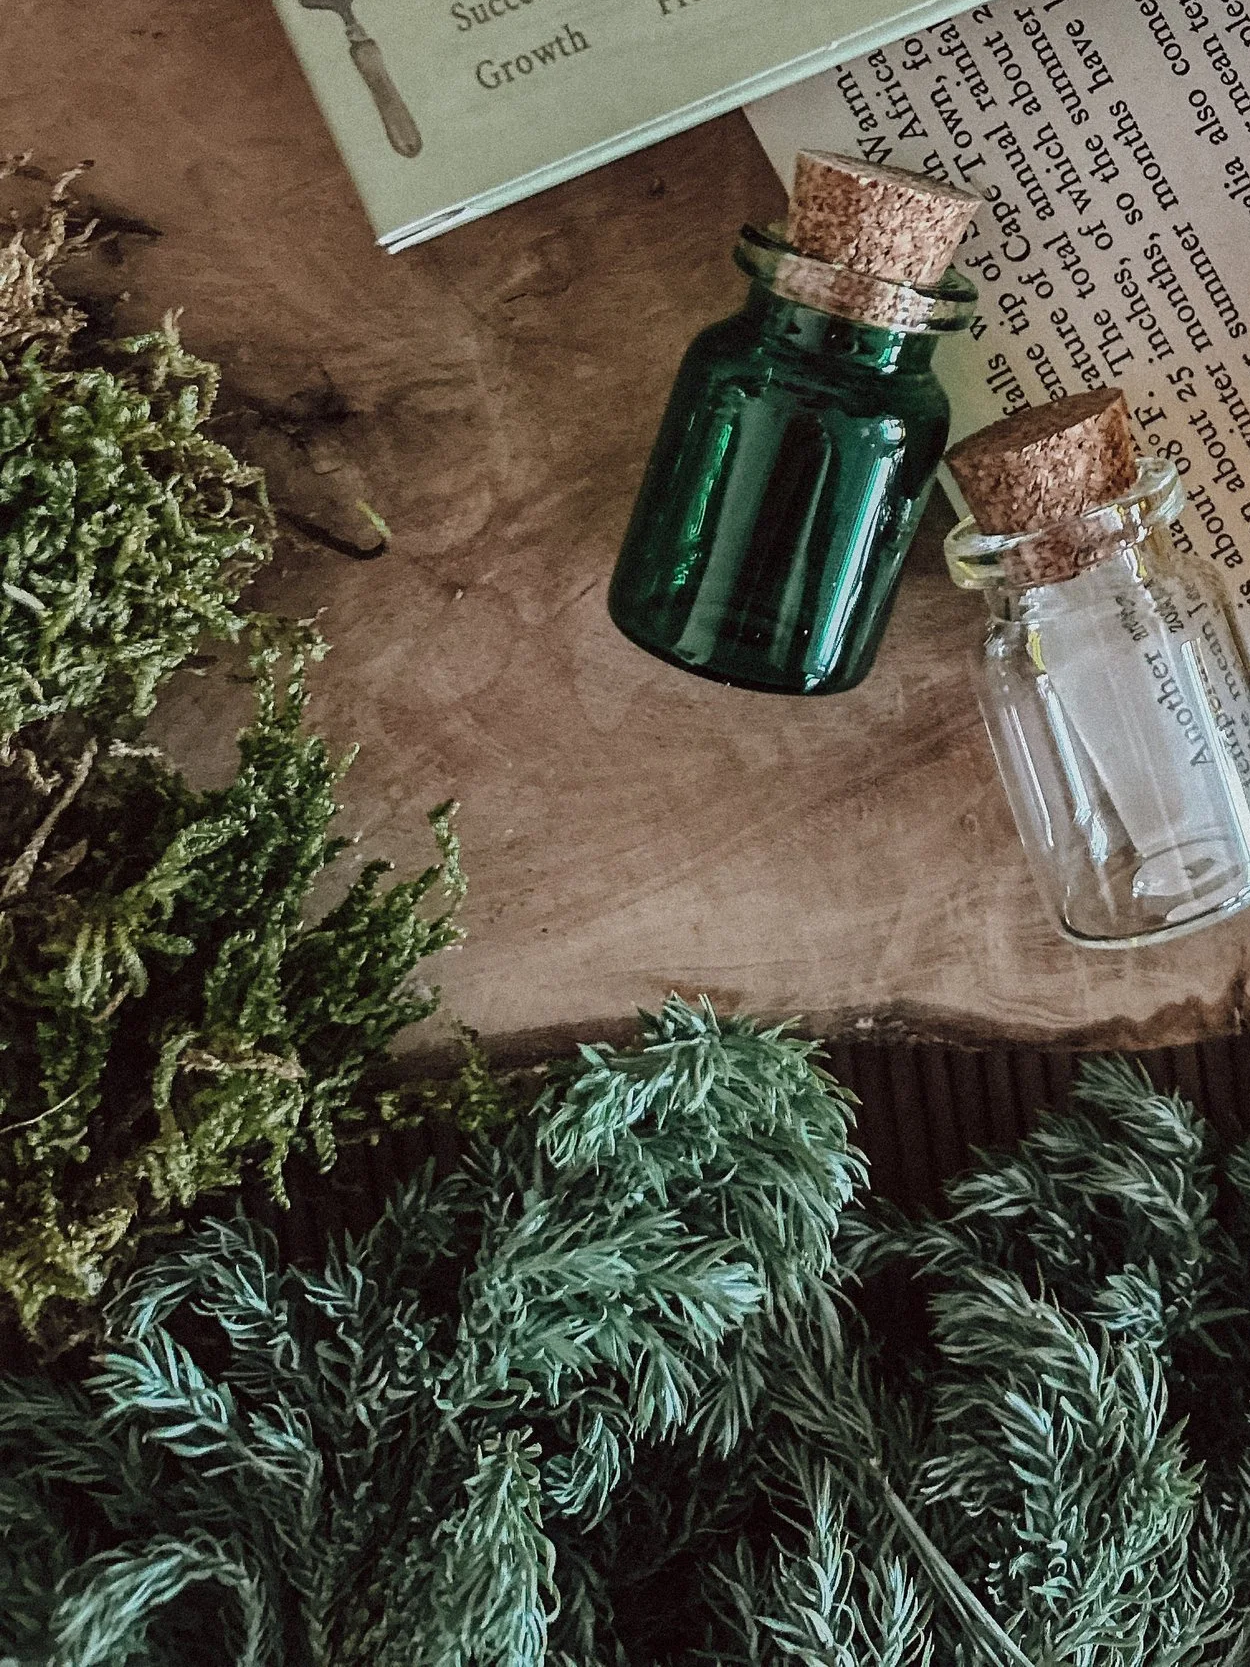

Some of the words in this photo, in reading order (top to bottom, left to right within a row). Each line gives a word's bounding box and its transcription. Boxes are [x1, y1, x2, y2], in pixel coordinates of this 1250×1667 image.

[473, 21, 592, 90] Growth
[981, 29, 1042, 117] about
[1012, 5, 1090, 126] summer
[1064, 17, 1115, 95] have
[929, 73, 987, 184] Town,
[1107, 98, 1180, 212] months
[1187, 87, 1229, 146] also
[981, 119, 1056, 222] annual
[1031, 120, 1092, 216] which
[1083, 132, 1120, 185] the
[968, 183, 1032, 263] Cape
[1076, 217, 1114, 251] of
[1114, 191, 1144, 226] so
[962, 249, 1002, 282] of
[1016, 266, 1055, 300] of
[1041, 229, 1097, 300] total
[1141, 231, 1214, 354] months,
[1170, 220, 1248, 339] summer
[996, 291, 1030, 336] tip
[1092, 307, 1135, 379] The
[1112, 256, 1175, 365] inches,
[984, 352, 1033, 418] falls
[1132, 389, 1168, 431] F.
[1164, 365, 1198, 404] 25
[1186, 407, 1246, 494] about
[1185, 483, 1244, 569] about
[1142, 648, 1216, 767] Another
